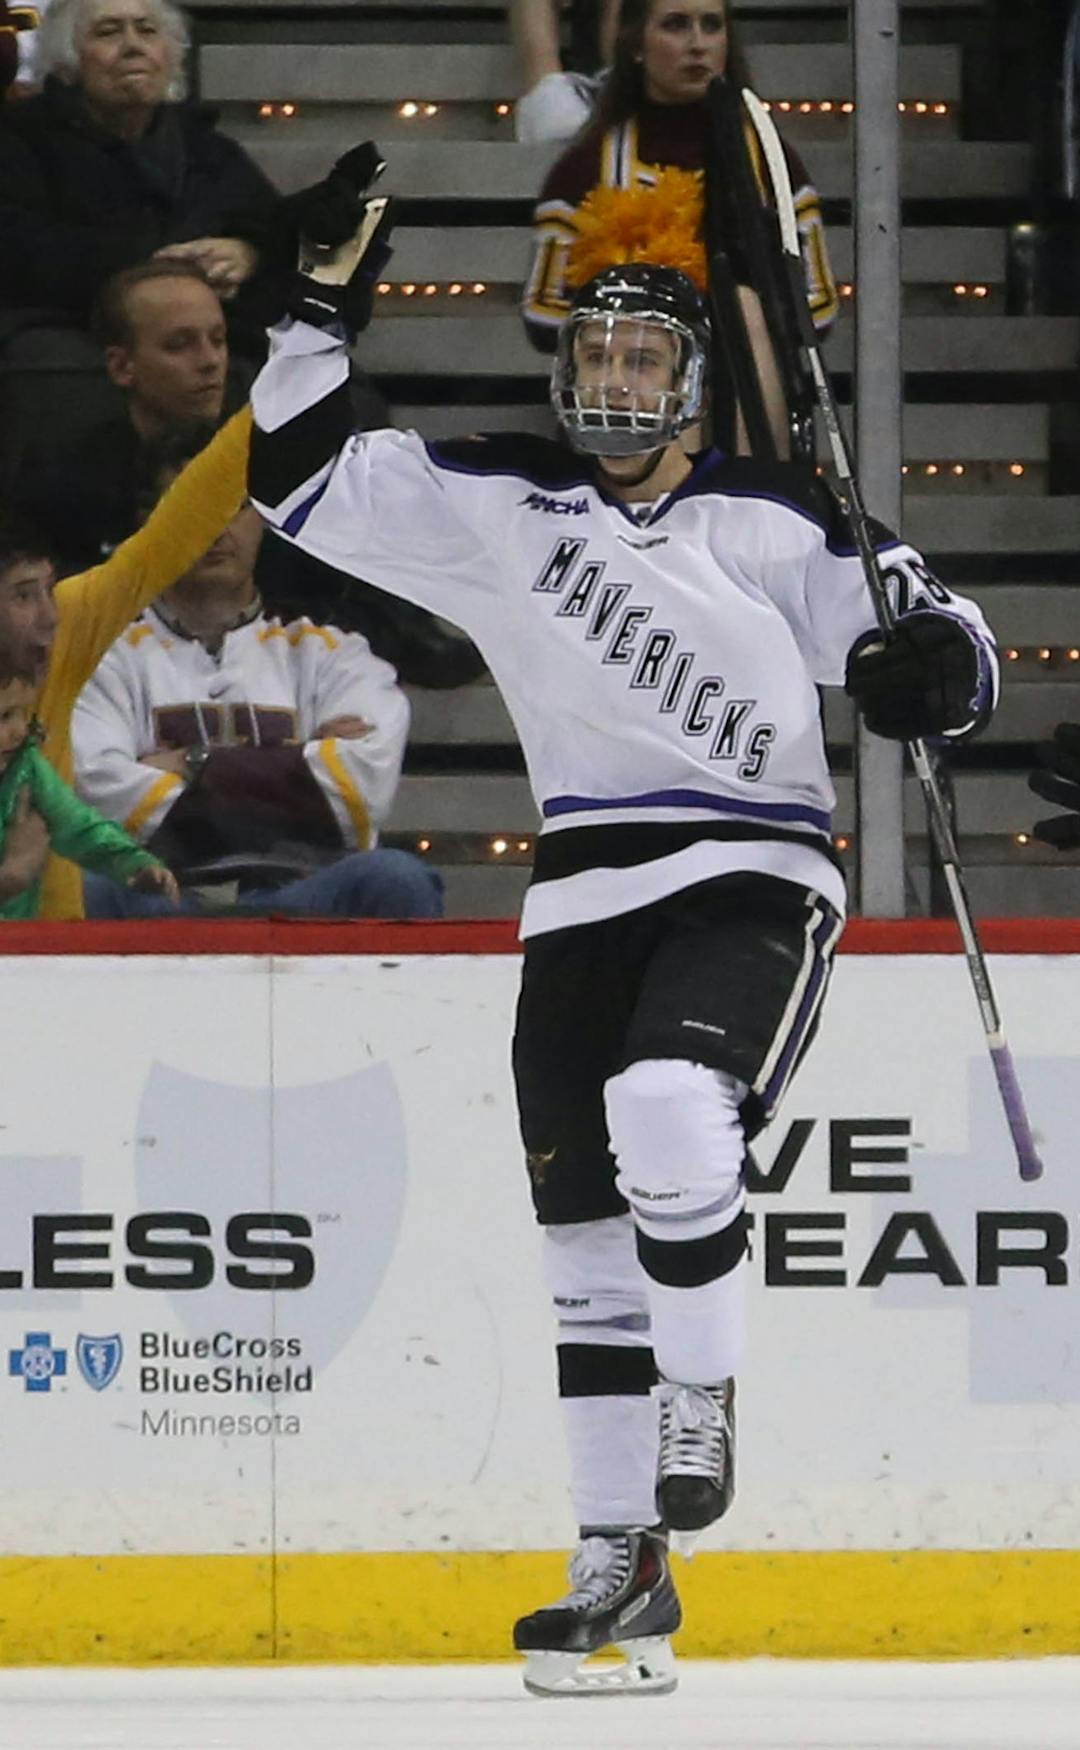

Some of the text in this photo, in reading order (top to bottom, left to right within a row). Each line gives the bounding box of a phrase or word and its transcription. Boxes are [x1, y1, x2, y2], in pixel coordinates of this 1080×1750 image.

[531, 536, 777, 782] MAVERICKS
[139, 1332, 302, 1359] BlueCross
[139, 1366, 313, 1394] BlueShield
[140, 1408, 301, 1437] Minnesota
